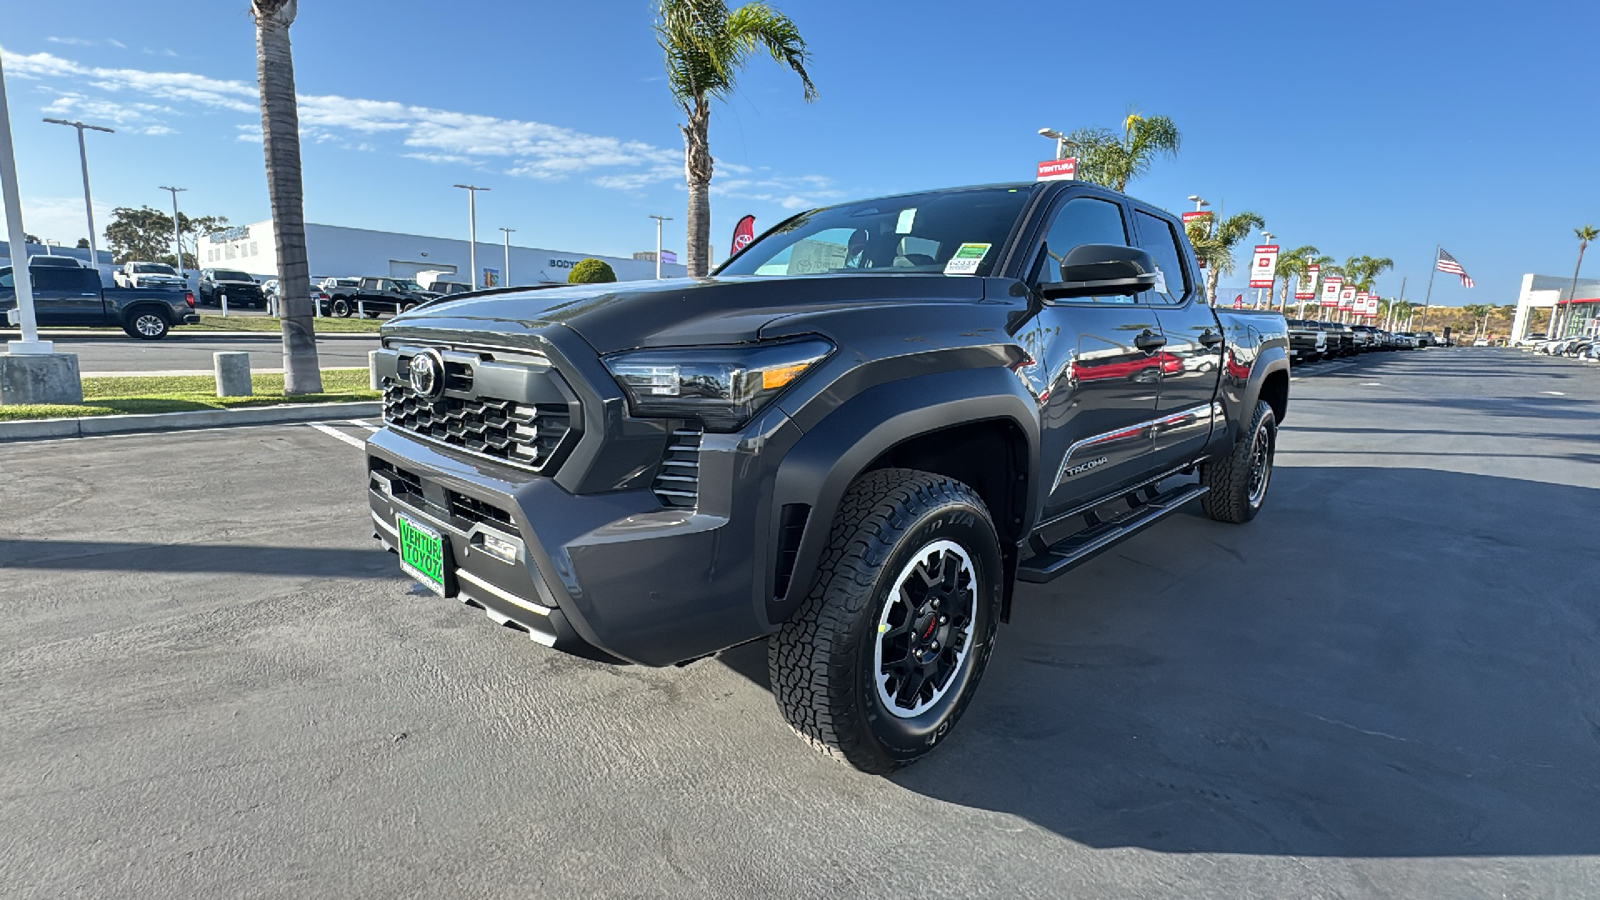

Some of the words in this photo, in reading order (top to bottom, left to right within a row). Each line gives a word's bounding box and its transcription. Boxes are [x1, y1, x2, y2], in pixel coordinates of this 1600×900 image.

[1039, 163, 1074, 173] VENTURA
[550, 259, 580, 269] BODY
[1066, 456, 1108, 475] TACOMA
